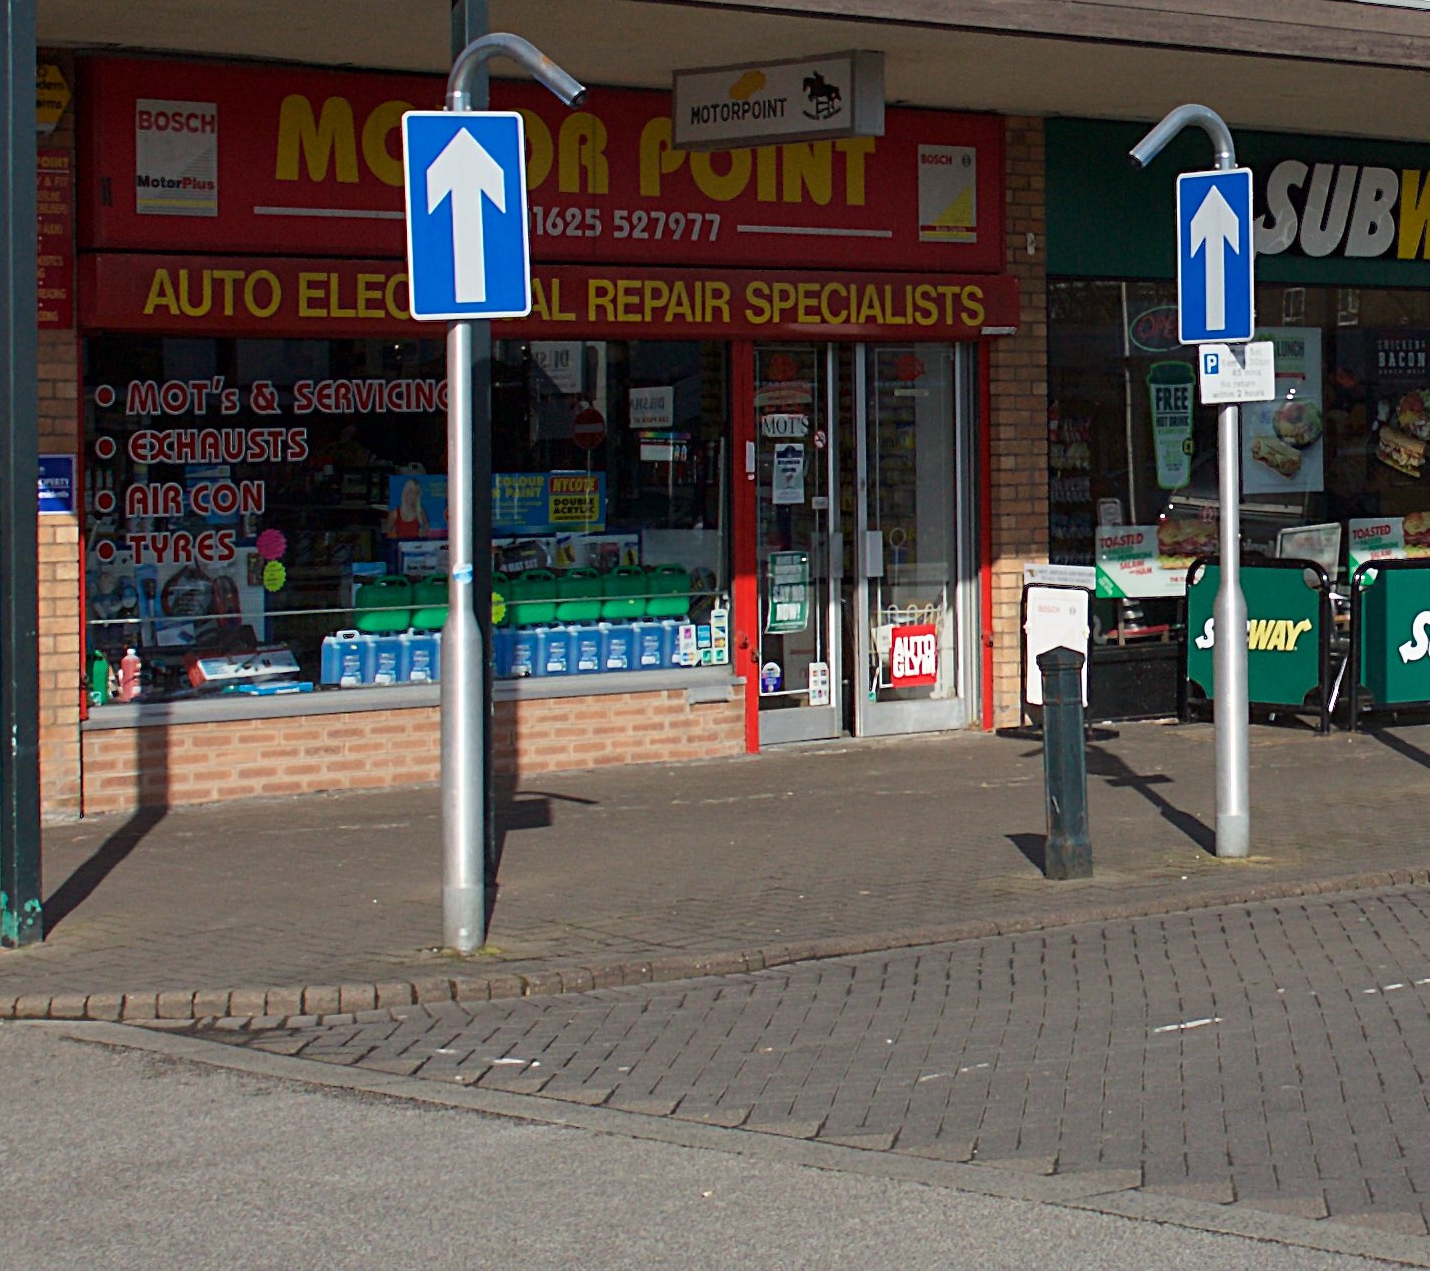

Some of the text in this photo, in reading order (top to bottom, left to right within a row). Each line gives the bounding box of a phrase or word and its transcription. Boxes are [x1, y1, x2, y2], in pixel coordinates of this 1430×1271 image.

[137, 110, 217, 134] BOSCH
[691, 97, 788, 124] MOTORPOINT
[39, 157, 70, 168] OINT
[276, 94, 875, 206] MOR POINT
[920, 153, 952, 165] BOSCH
[528, 206, 721, 241] 1625 527977
[143, 268, 986, 327] AUTO ELECAL REPAIR SPECIALISTS
[1135, 314, 1179, 340] OPE
[1378, 352, 1426, 368] BACON
[126, 375, 240, 416] MOT's
[250, 380, 282, 415] &
[1155, 387, 1188, 411] FREE
[128, 428, 309, 464] EXHAUSTS
[126, 480, 265, 519] AIR CON
[553, 496, 596, 506] DOUBLE
[1099, 533, 1144, 550] TOASTED
[1352, 524, 1392, 540] TOASTED
[128, 530, 236, 565] TYRES
[893, 635, 935, 656] AUTO
[1195, 617, 1313, 652] SWAY
[893, 654, 936, 678] GLYM
